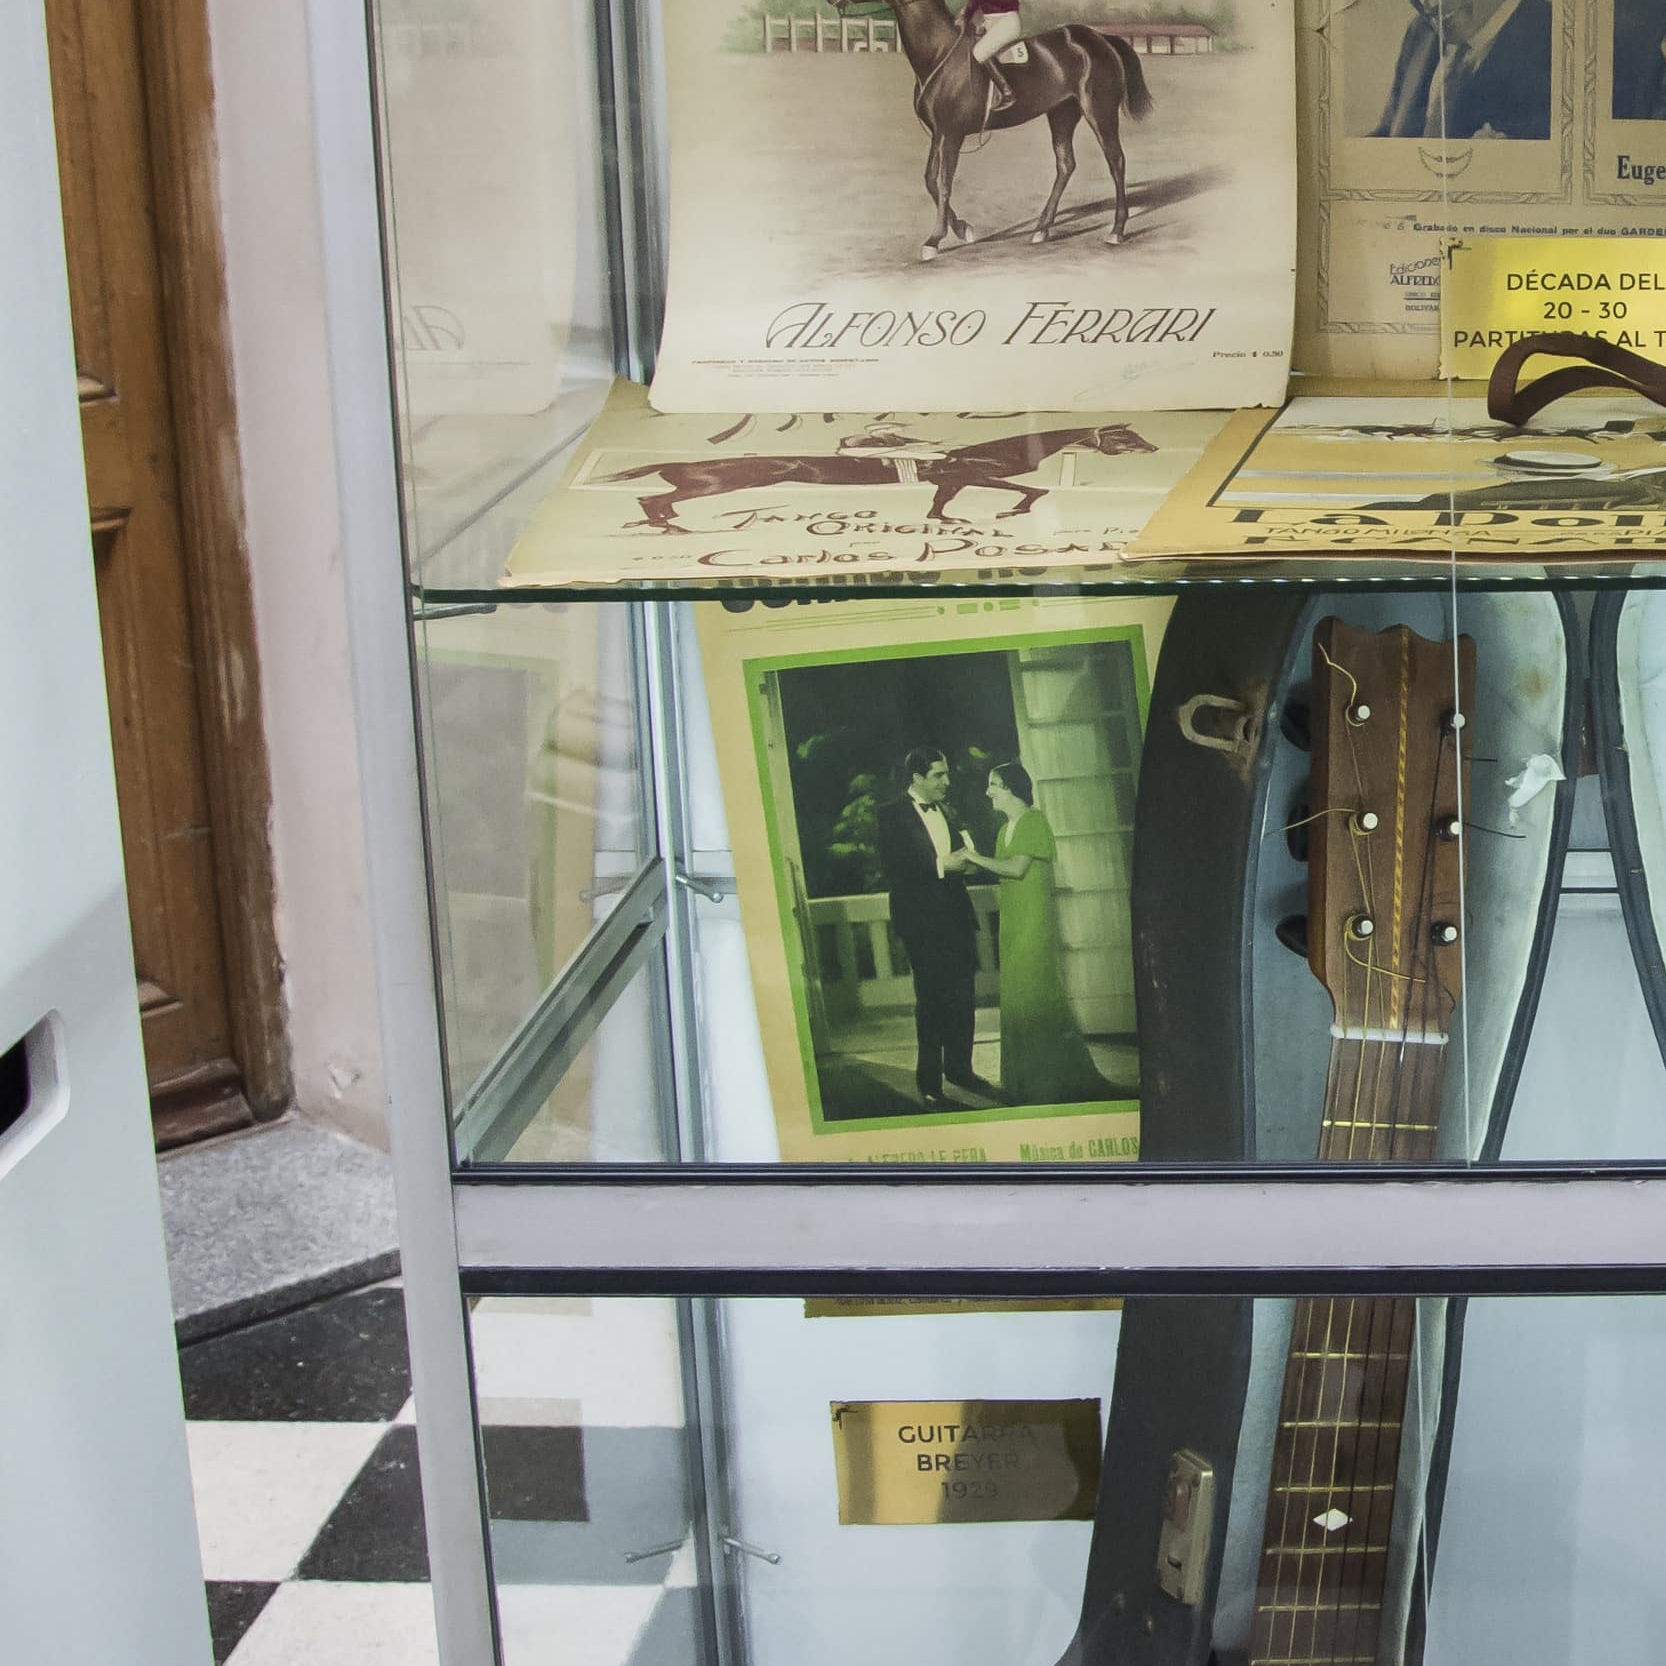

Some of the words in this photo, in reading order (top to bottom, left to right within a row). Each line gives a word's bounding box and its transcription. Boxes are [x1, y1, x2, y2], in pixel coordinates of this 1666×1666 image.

[1413, 222, 1458, 233] Grabado
[1511, 225, 1558, 235] Nacional
[1506, 268, 1612, 291] DÉCADA
[1619, 272, 1666, 291] DEL
[1543, 301, 1573, 319] 20
[1598, 301, 1628, 319] 30
[765, 301, 988, 349] ALFONSO
[1003, 300, 1218, 347] FERRARI
[1616, 330, 1647, 348] AL
[697, 548, 896, 567] Carlos
[1088, 1136, 1139, 1158] CARLOS
[898, 1424, 1037, 1444] GUITARRA
[916, 1452, 1021, 1471] BREYER
[941, 1481, 999, 1500] 1929
